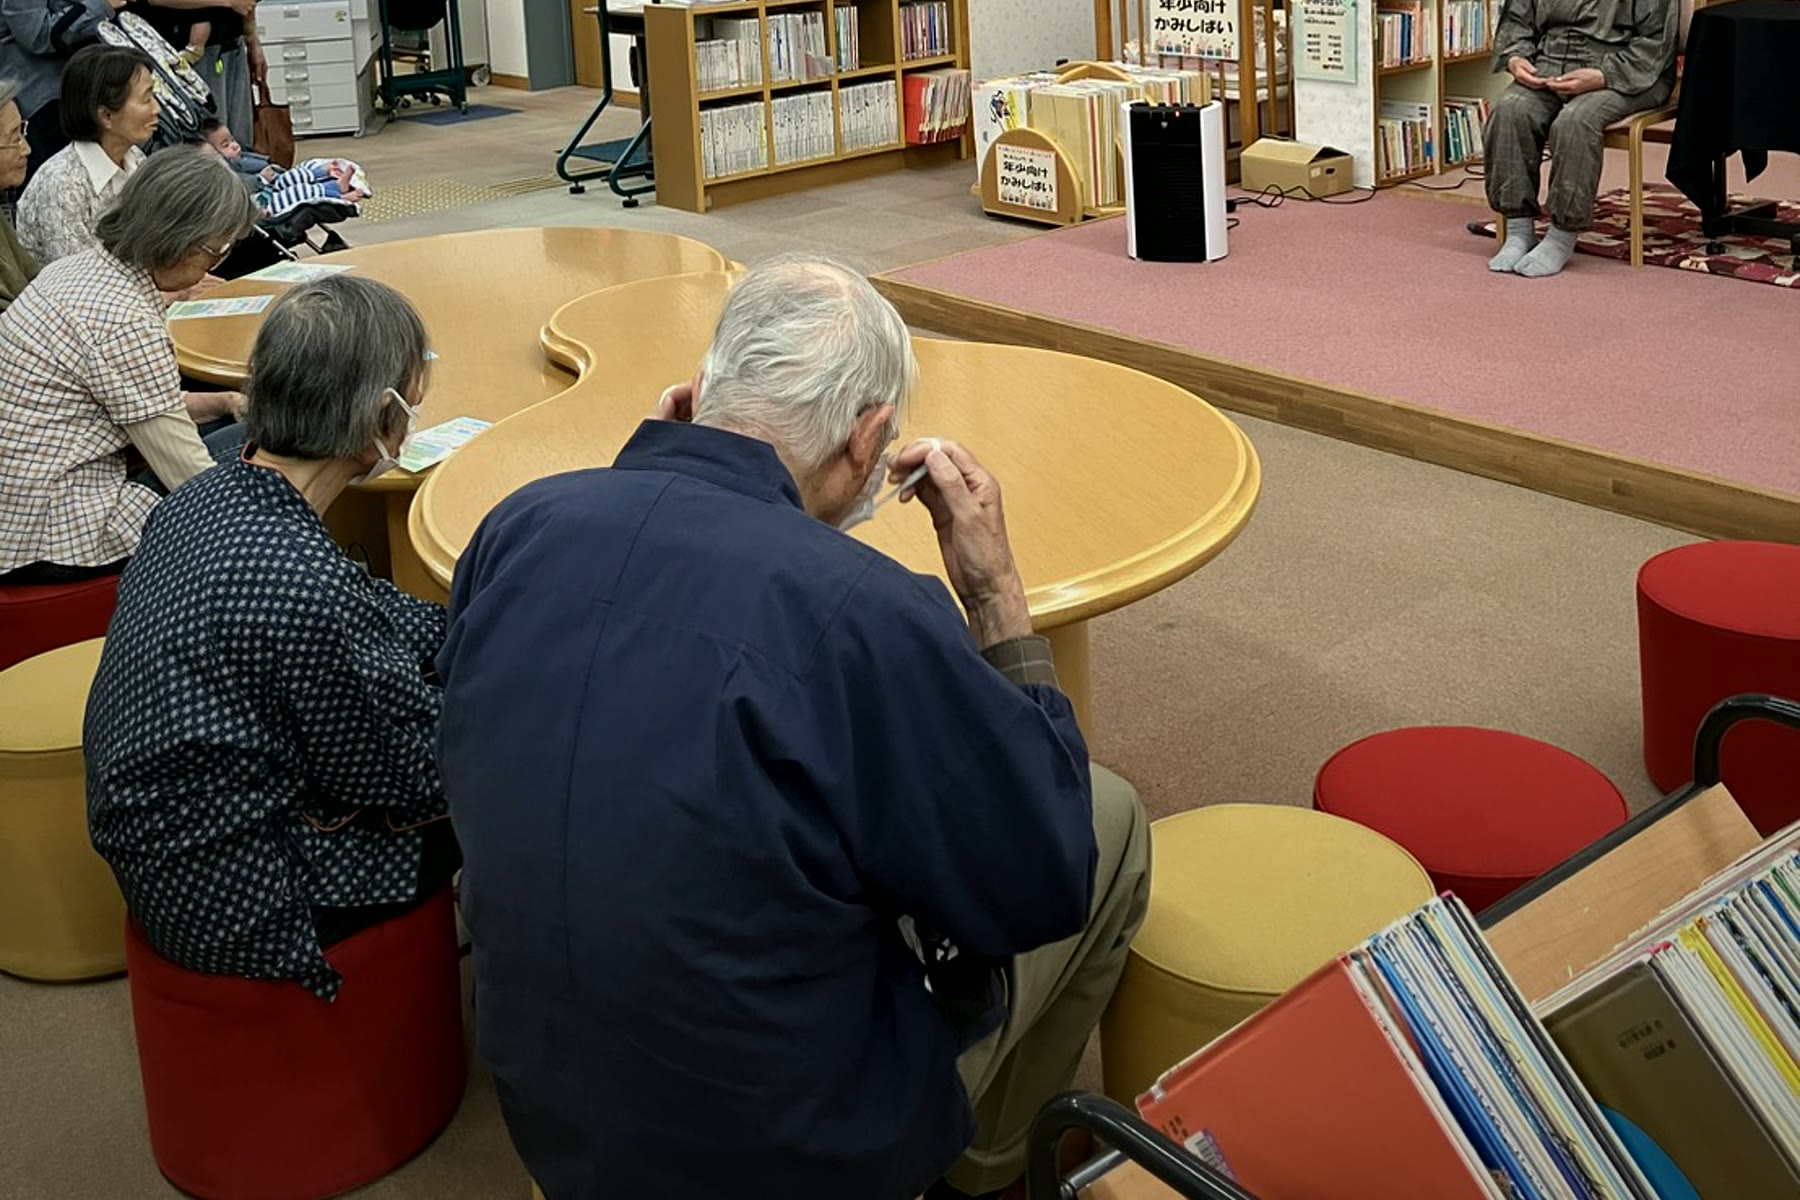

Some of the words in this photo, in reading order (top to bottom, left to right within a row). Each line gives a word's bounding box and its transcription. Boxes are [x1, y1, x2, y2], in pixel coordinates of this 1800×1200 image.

[1154, 16, 1234, 34] かみしばい
[1003, 160, 1048, 179] 年少向け
[1000, 175, 1053, 193] かみしばい
